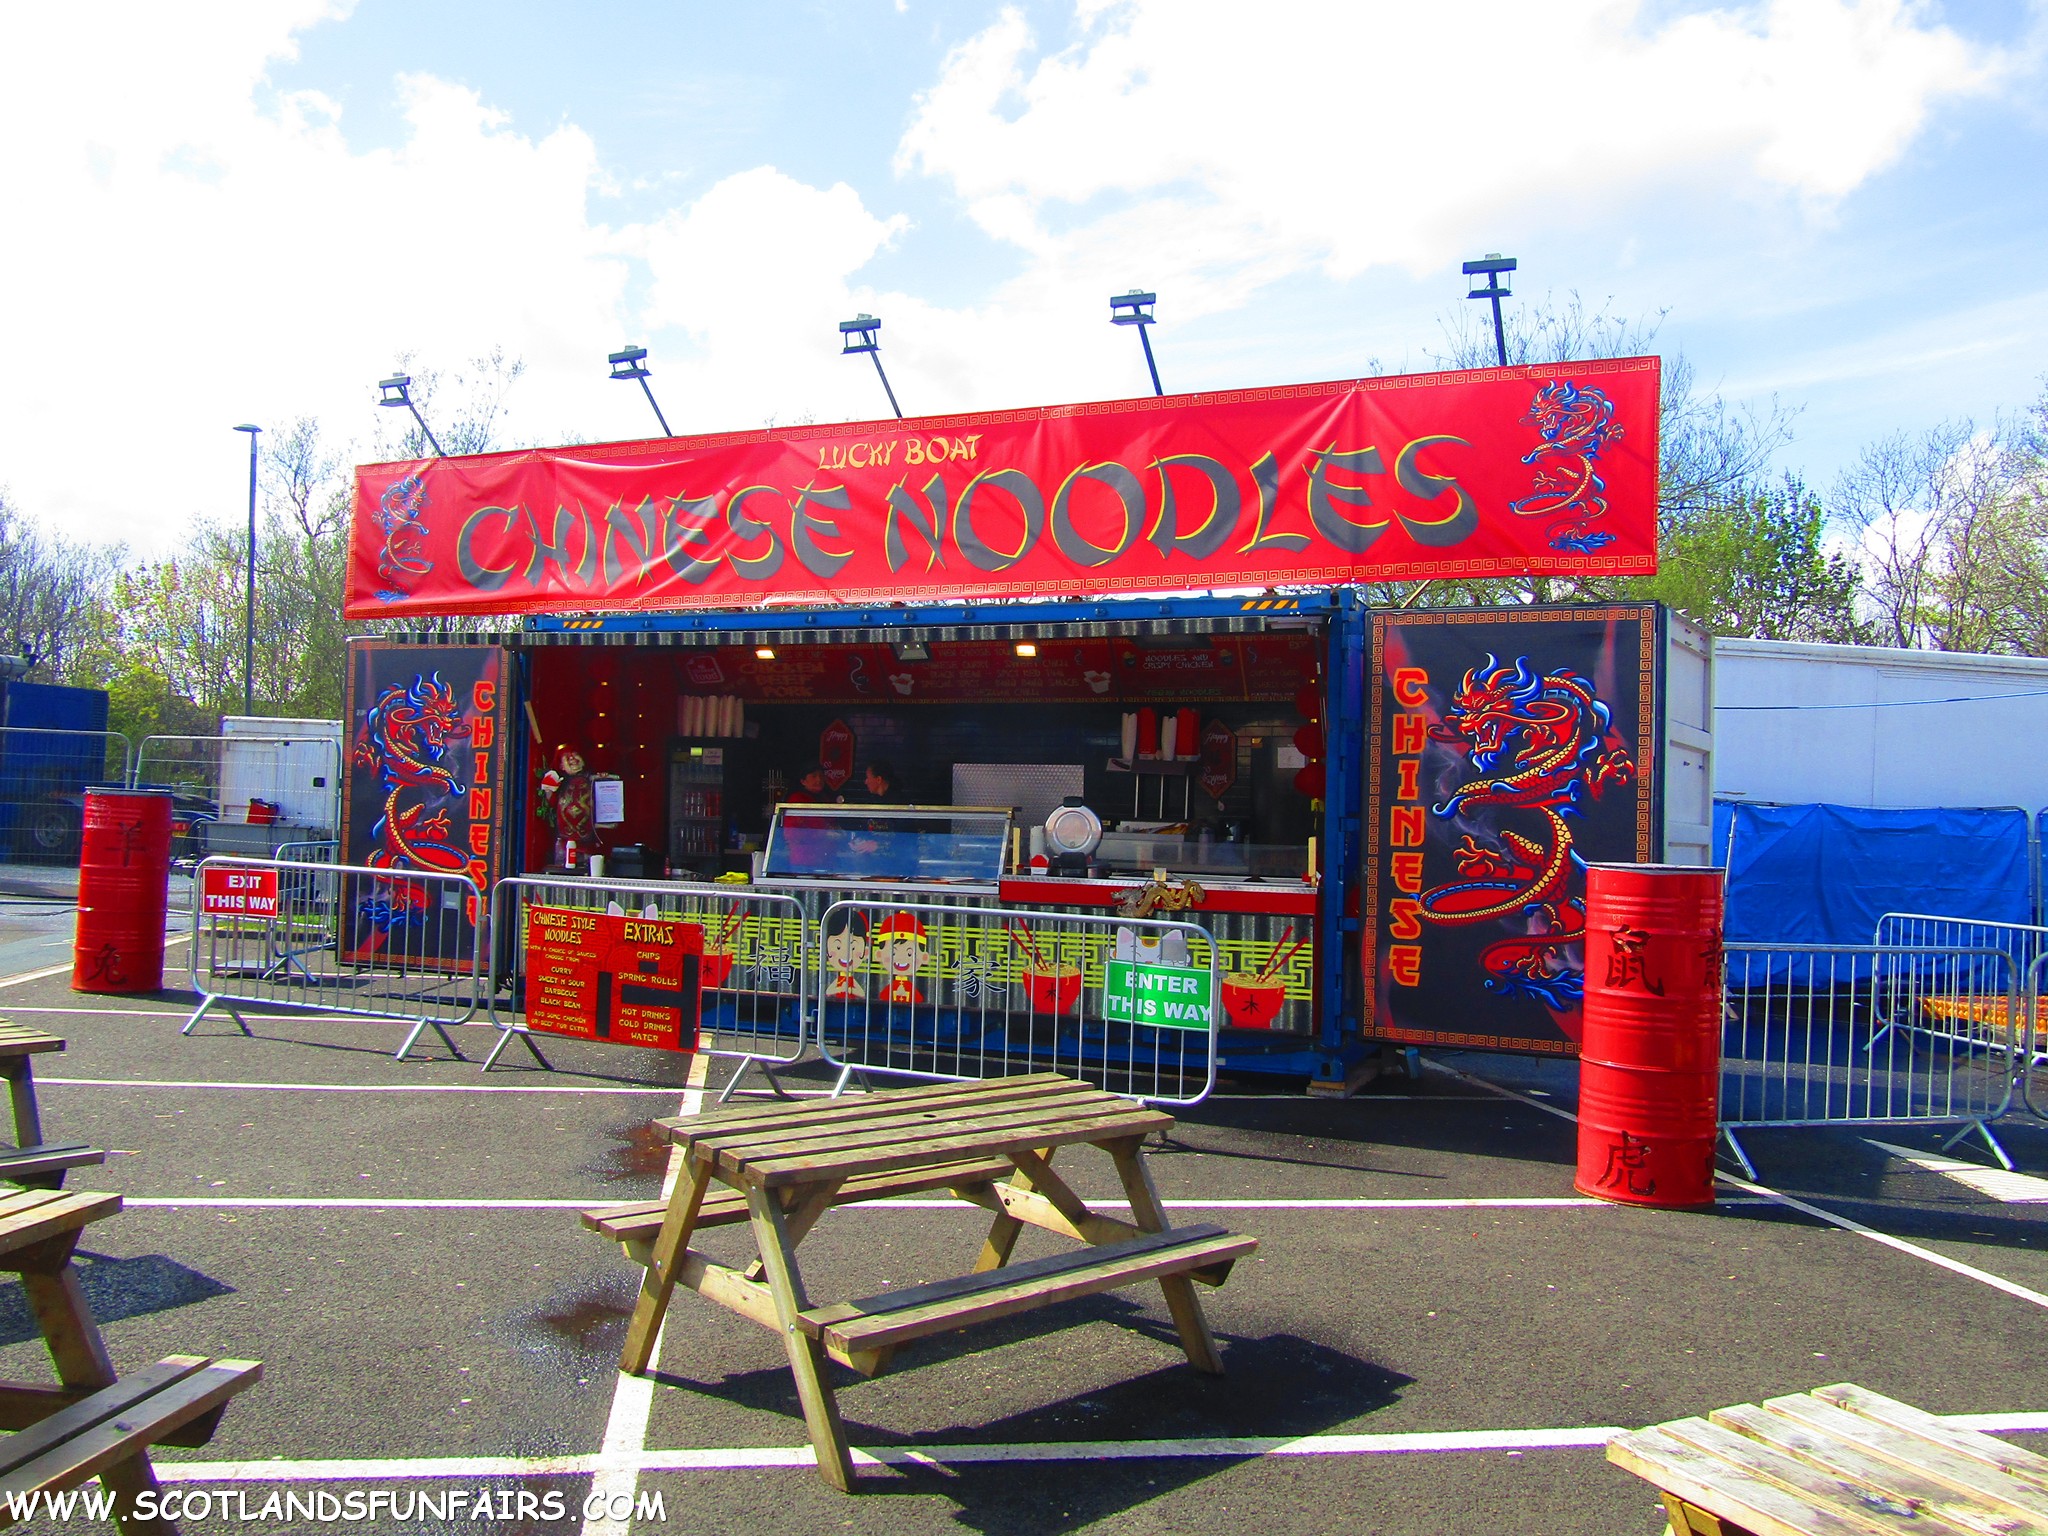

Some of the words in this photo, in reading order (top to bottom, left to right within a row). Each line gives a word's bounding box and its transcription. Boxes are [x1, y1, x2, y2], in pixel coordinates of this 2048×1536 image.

[817, 440, 897, 471] LUCKY
[905, 433, 985, 465] BOAT
[456, 480, 855, 592] CHINESE
[885, 435, 1480, 574] NOODLES
[1176, 661, 1214, 669] CHICKEN
[466, 681, 496, 927] CHINESE
[1389, 667, 1429, 987] CHINESE
[228, 875, 261, 889] EXIT
[206, 895, 245, 908] THIS
[249, 896, 275, 910] WAY
[533, 911, 568, 927] CHINESE
[571, 917, 596, 930] STYLE
[544, 929, 582, 944] NOODLES
[624, 922, 674, 945] EXTRAS
[636, 951, 660, 960] CHIPS
[551, 966, 573, 975] CURRY
[746, 945, 797, 985] 福
[538, 975, 558, 984] SWEET
[568, 979, 585, 987] SOUR
[618, 972, 646, 982] SPRING
[651, 976, 678, 986] ROLLS
[951, 955, 1007, 998] 家
[1125, 971, 1198, 994] ENTER
[544, 986, 578, 998] BARBECUE
[540, 997, 561, 1006] BLACK
[564, 1000, 581, 1009] BEAN
[1108, 994, 1157, 1016] THIS
[1163, 1002, 1211, 1021] WAY
[622, 1008, 637, 1016] HOT
[641, 1010, 670, 1020] DRINKS
[619, 1019, 639, 1028] COLD
[643, 1022, 673, 1032] DRINKS
[631, 1032, 659, 1042] WATER
[1594, 1130, 1656, 1196] 虎
